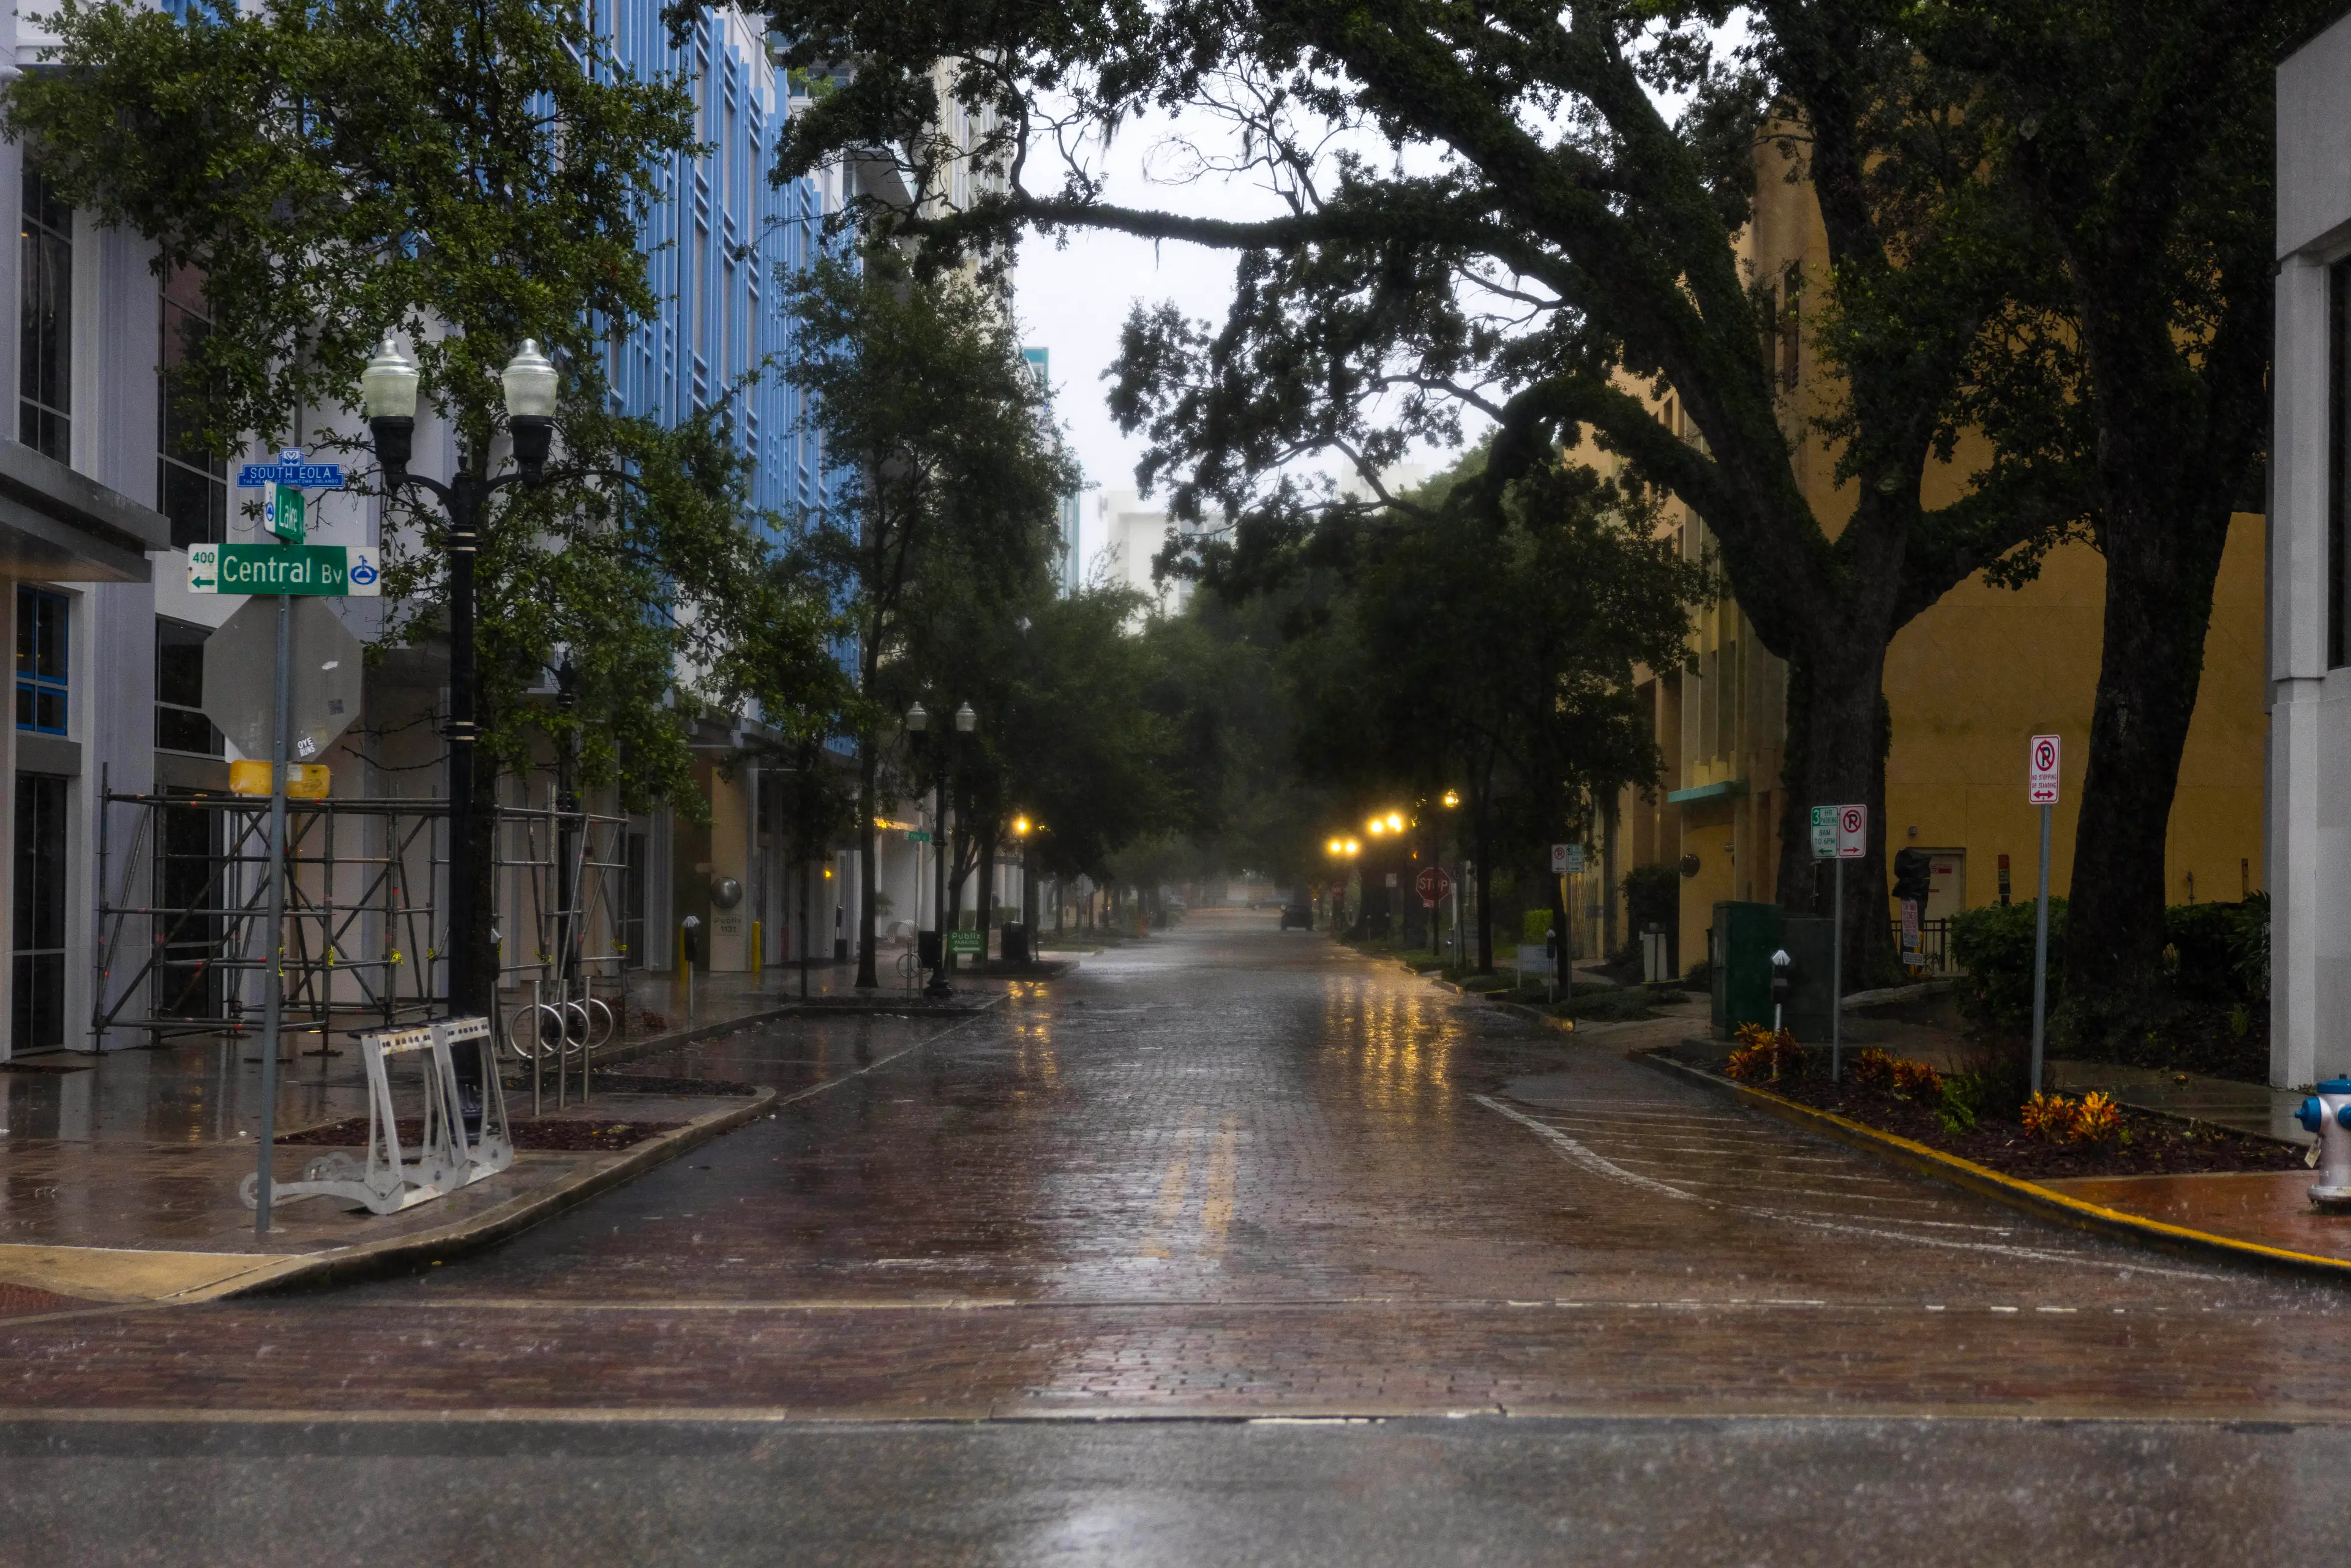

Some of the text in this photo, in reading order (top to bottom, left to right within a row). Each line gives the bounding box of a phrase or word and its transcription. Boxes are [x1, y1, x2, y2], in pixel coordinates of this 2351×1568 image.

[250, 467, 331, 478] SOUTH EOLA
[279, 495, 298, 532] Lake
[193, 552, 215, 563] 400
[223, 555, 343, 584] Central Bv
[297, 737, 313, 749] OYE
[299, 744, 315, 757] RUNS
[1813, 809, 1820, 825] 3
